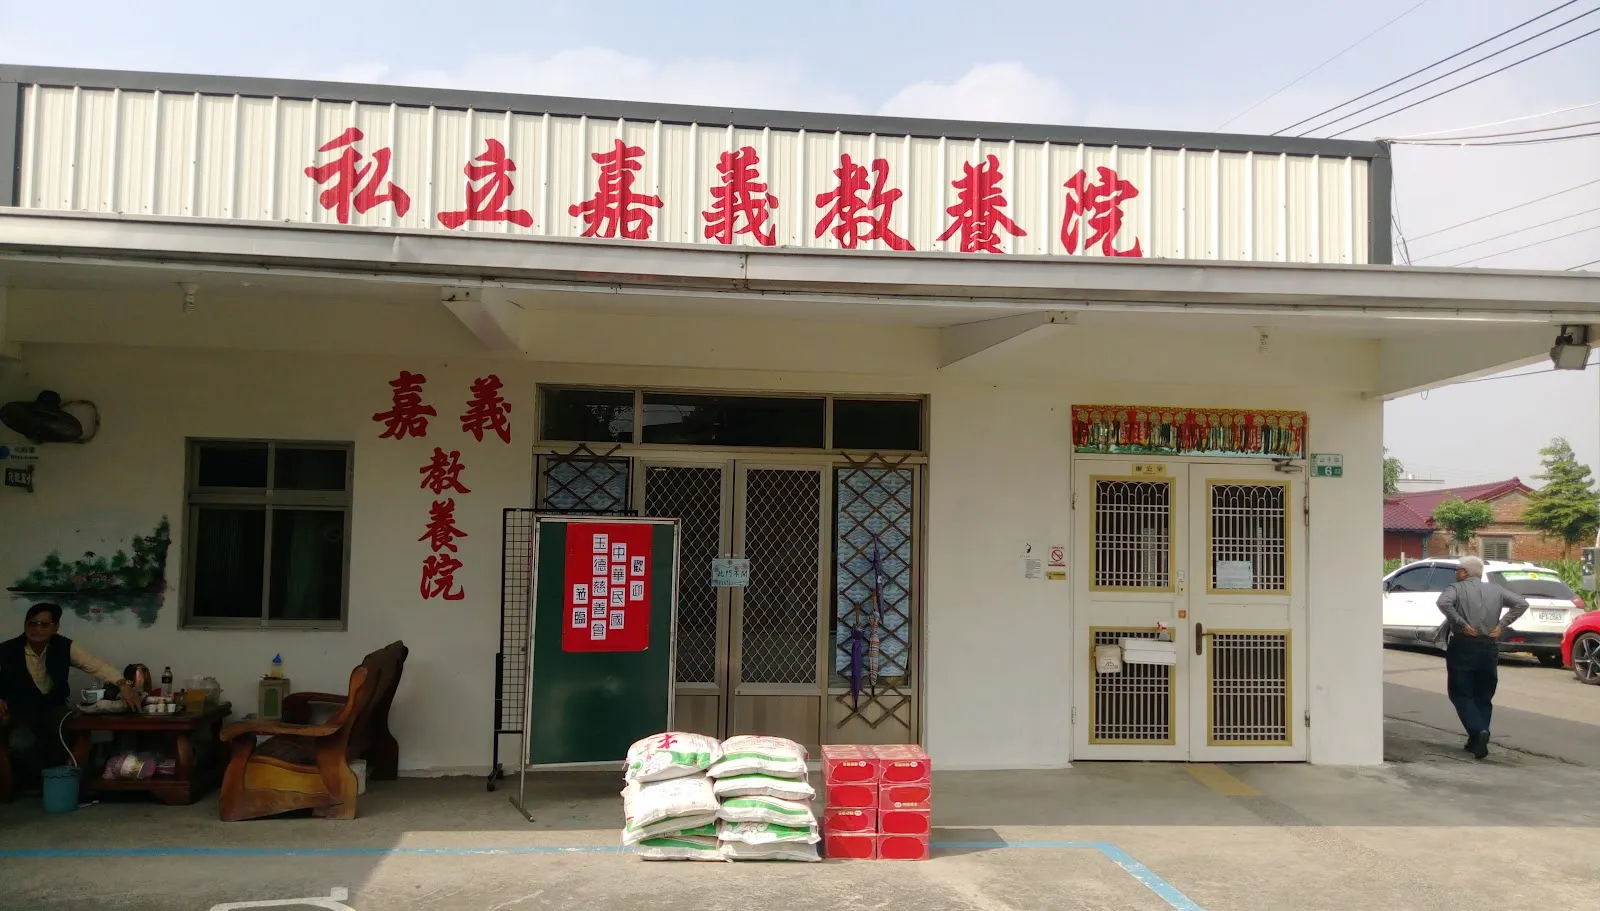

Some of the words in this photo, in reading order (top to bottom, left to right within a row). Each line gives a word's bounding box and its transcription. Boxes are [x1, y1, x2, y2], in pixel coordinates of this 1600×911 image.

[304, 127, 1142, 258] 私立嘉義教養院
[418, 447, 471, 600] 教養院
[574, 586, 587, 625] 蒞臨
[592, 536, 607, 637] 玉德慈善會
[610, 545, 625, 627] 中華民國
[631, 558, 644, 599] 歡迎
